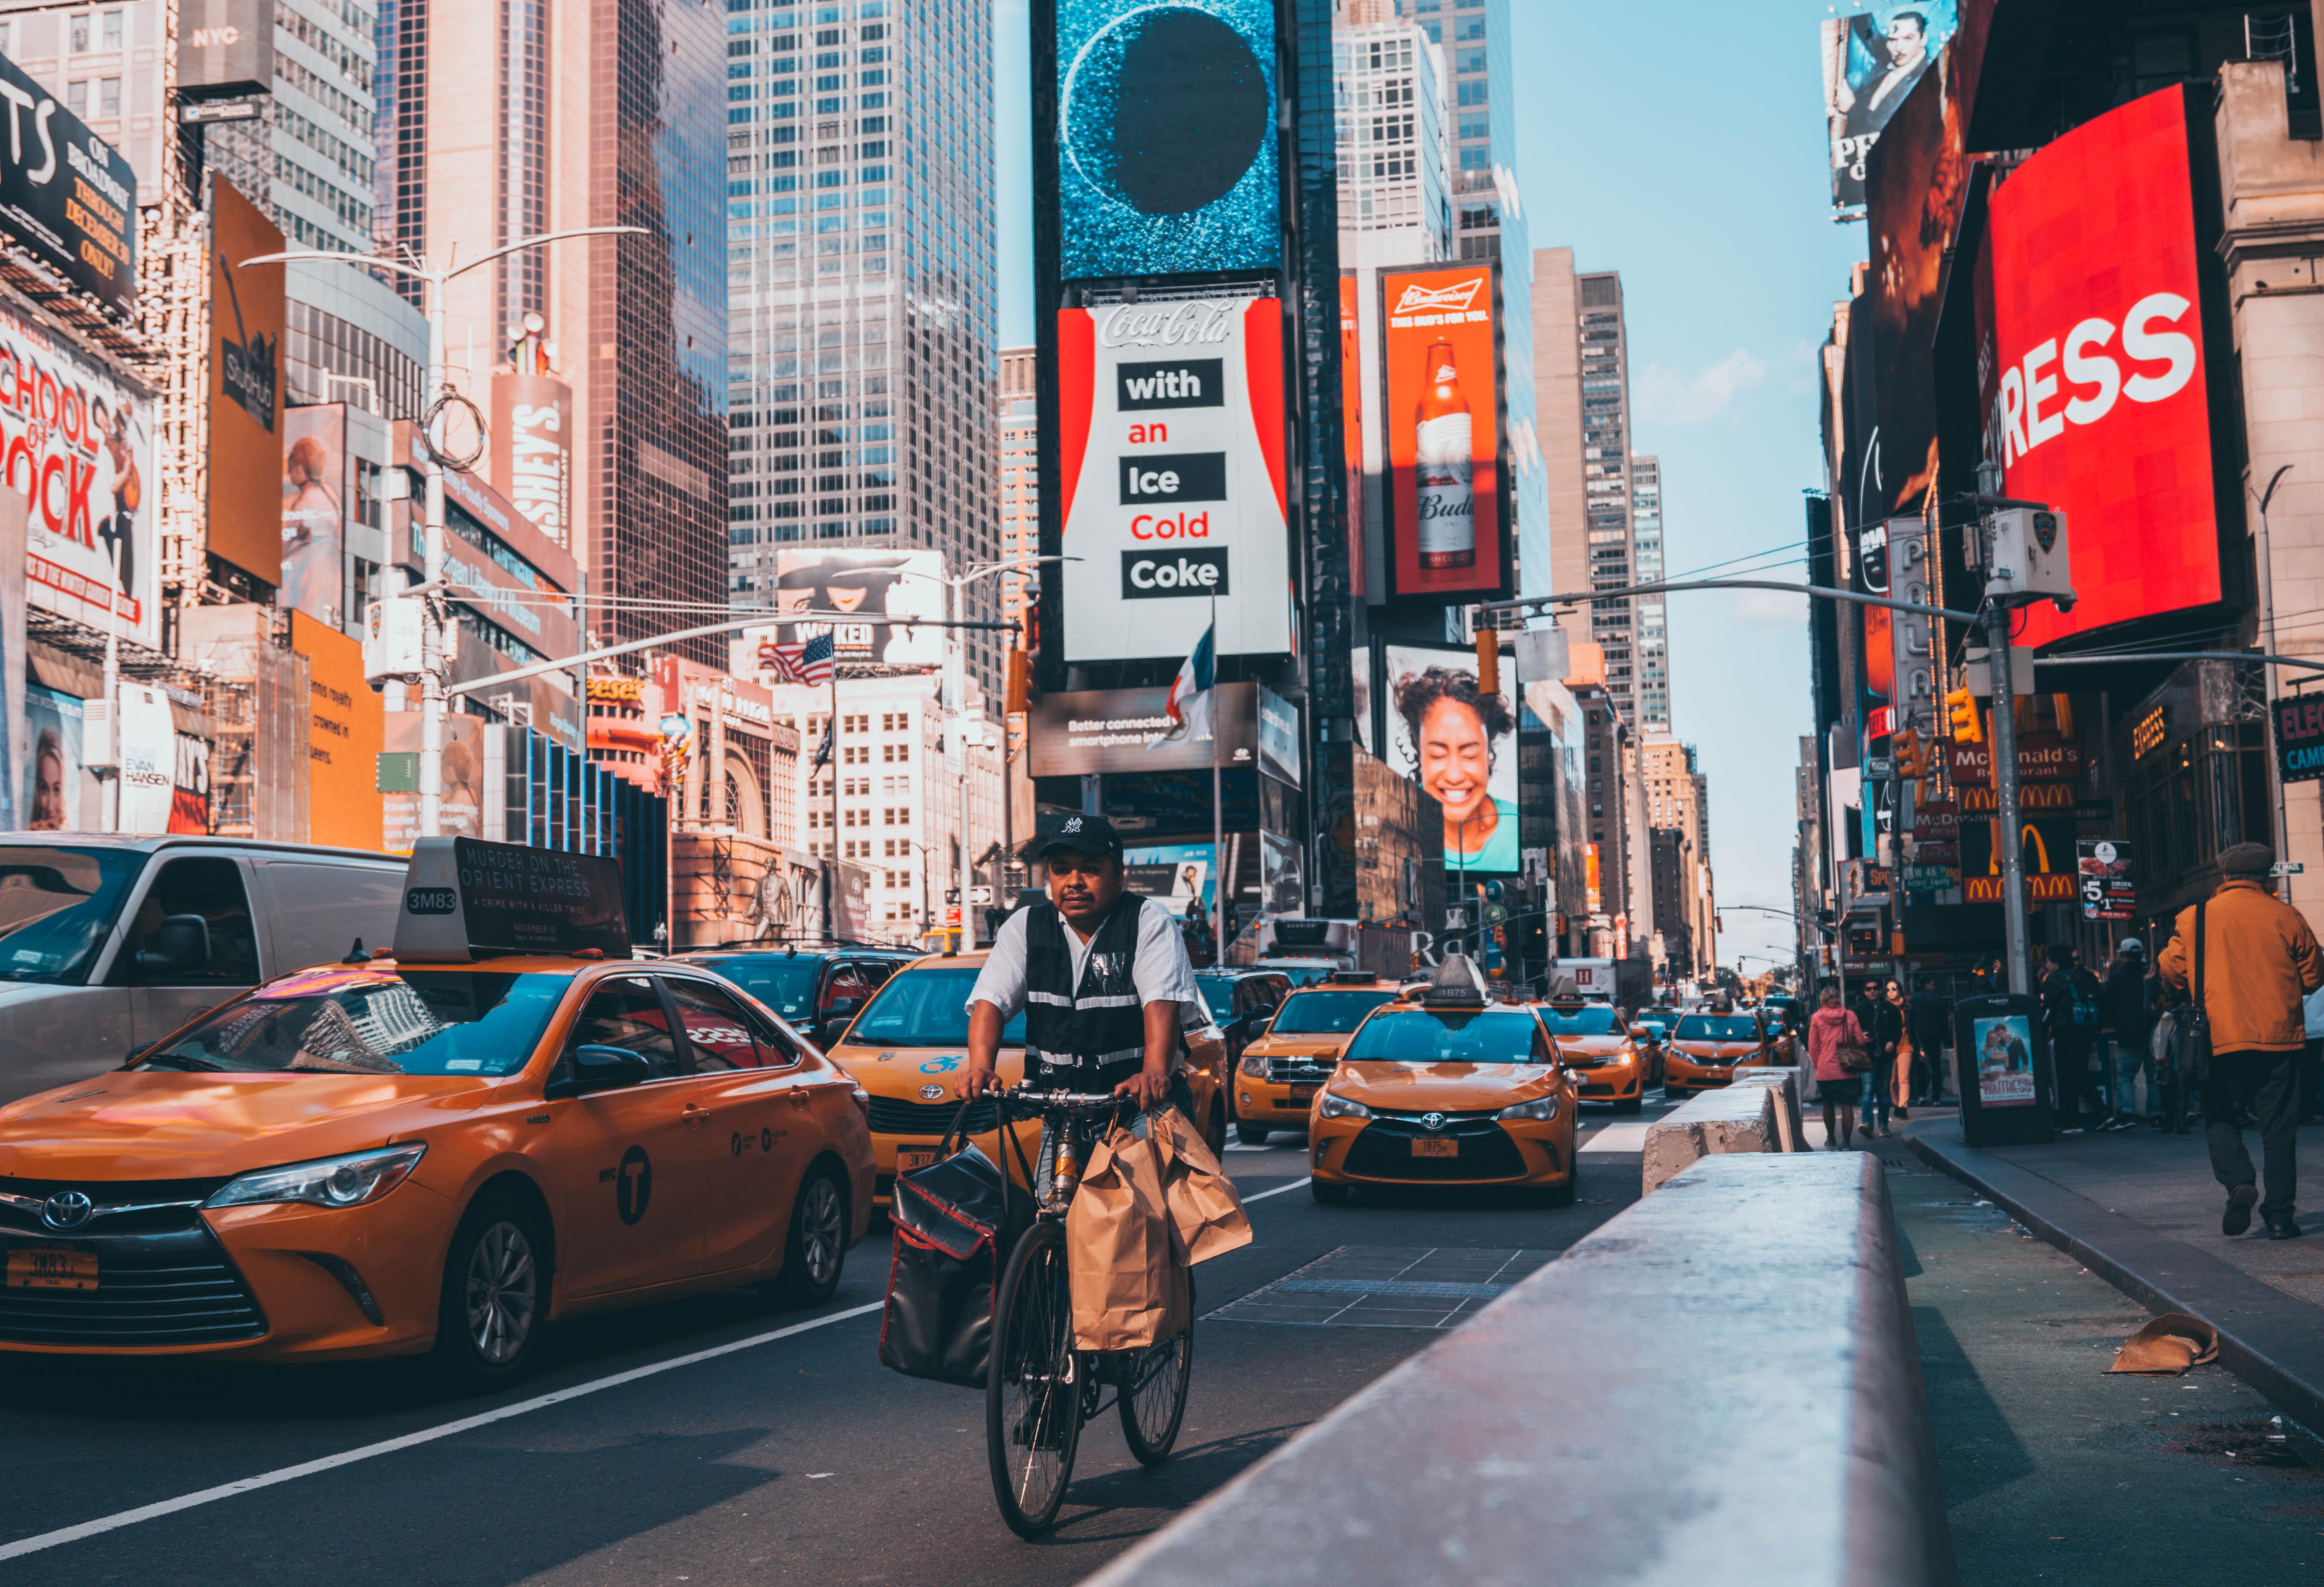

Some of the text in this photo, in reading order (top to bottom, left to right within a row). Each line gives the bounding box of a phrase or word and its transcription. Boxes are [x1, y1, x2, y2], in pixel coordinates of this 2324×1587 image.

[192, 25, 238, 48] NYC
[89, 136, 109, 169] ON
[67, 141, 130, 211] BROADWAY
[73, 176, 124, 234] THROUGH
[1402, 290, 1473, 306] Budweiser
[1390, 310, 1489, 328] THIS BUD'S FOR YOU.
[227, 353, 271, 408] StubHub
[1126, 370, 1200, 399] with
[1128, 423, 1167, 444] an
[0, 420, 97, 551] OCK
[1129, 467, 1180, 495] Ice
[1131, 511, 1209, 540] Cold
[412, 520, 426, 558] Th
[1429, 554, 1471, 563] NHEUSER
[1131, 559, 1219, 589] Coke
[1902, 538, 1935, 782] PALAC
[587, 678, 646, 700] eese's
[329, 689, 352, 712] royalty
[313, 714, 348, 739] crowned in
[1069, 715, 1171, 732] Better connected
[1069, 733, 1143, 747] smartphone
[311, 745, 332, 765] ueens.
[1956, 748, 2077, 766] Mcnald's
[126, 770, 170, 786] HANSEN
[466, 848, 579, 877] MURDER ON THE
[1915, 868, 1922, 877] W
[1926, 867, 1937, 877] 46
[461, 868, 590, 898] ORIENT EXPRESS
[409, 893, 455, 909] 3M83
[482, 898, 506, 908] CRIME
[509, 900, 528, 910] WITH
[538, 903, 563, 913] KILLER
[565, 905, 585, 915] TWIST
[513, 924, 548, 934] NOVEMBER
[1579, 971, 1589, 983] H
[599, 1167, 617, 1183] NYC
